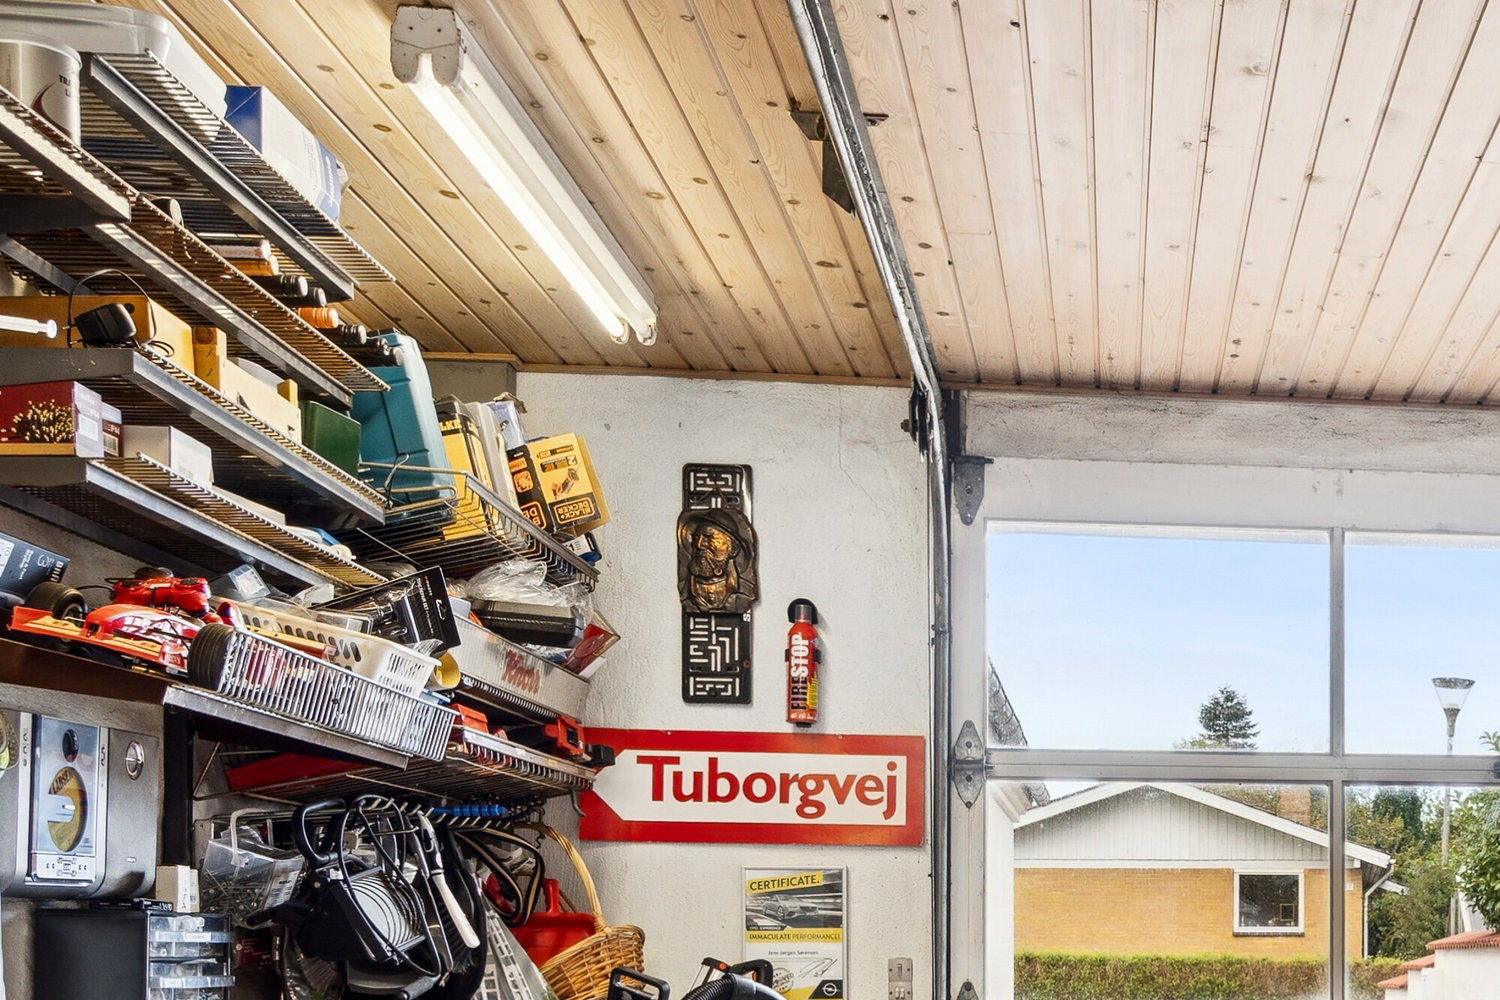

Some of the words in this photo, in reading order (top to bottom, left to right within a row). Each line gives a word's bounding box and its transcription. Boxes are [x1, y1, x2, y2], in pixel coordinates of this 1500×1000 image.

[557, 500, 590, 513] DECKER
[50, 560, 64, 582] BRA
[791, 633, 809, 710] FIRESTOP
[636, 755, 898, 820] Tuborgvej
[749, 874, 820, 891] CERTIFICATE.
